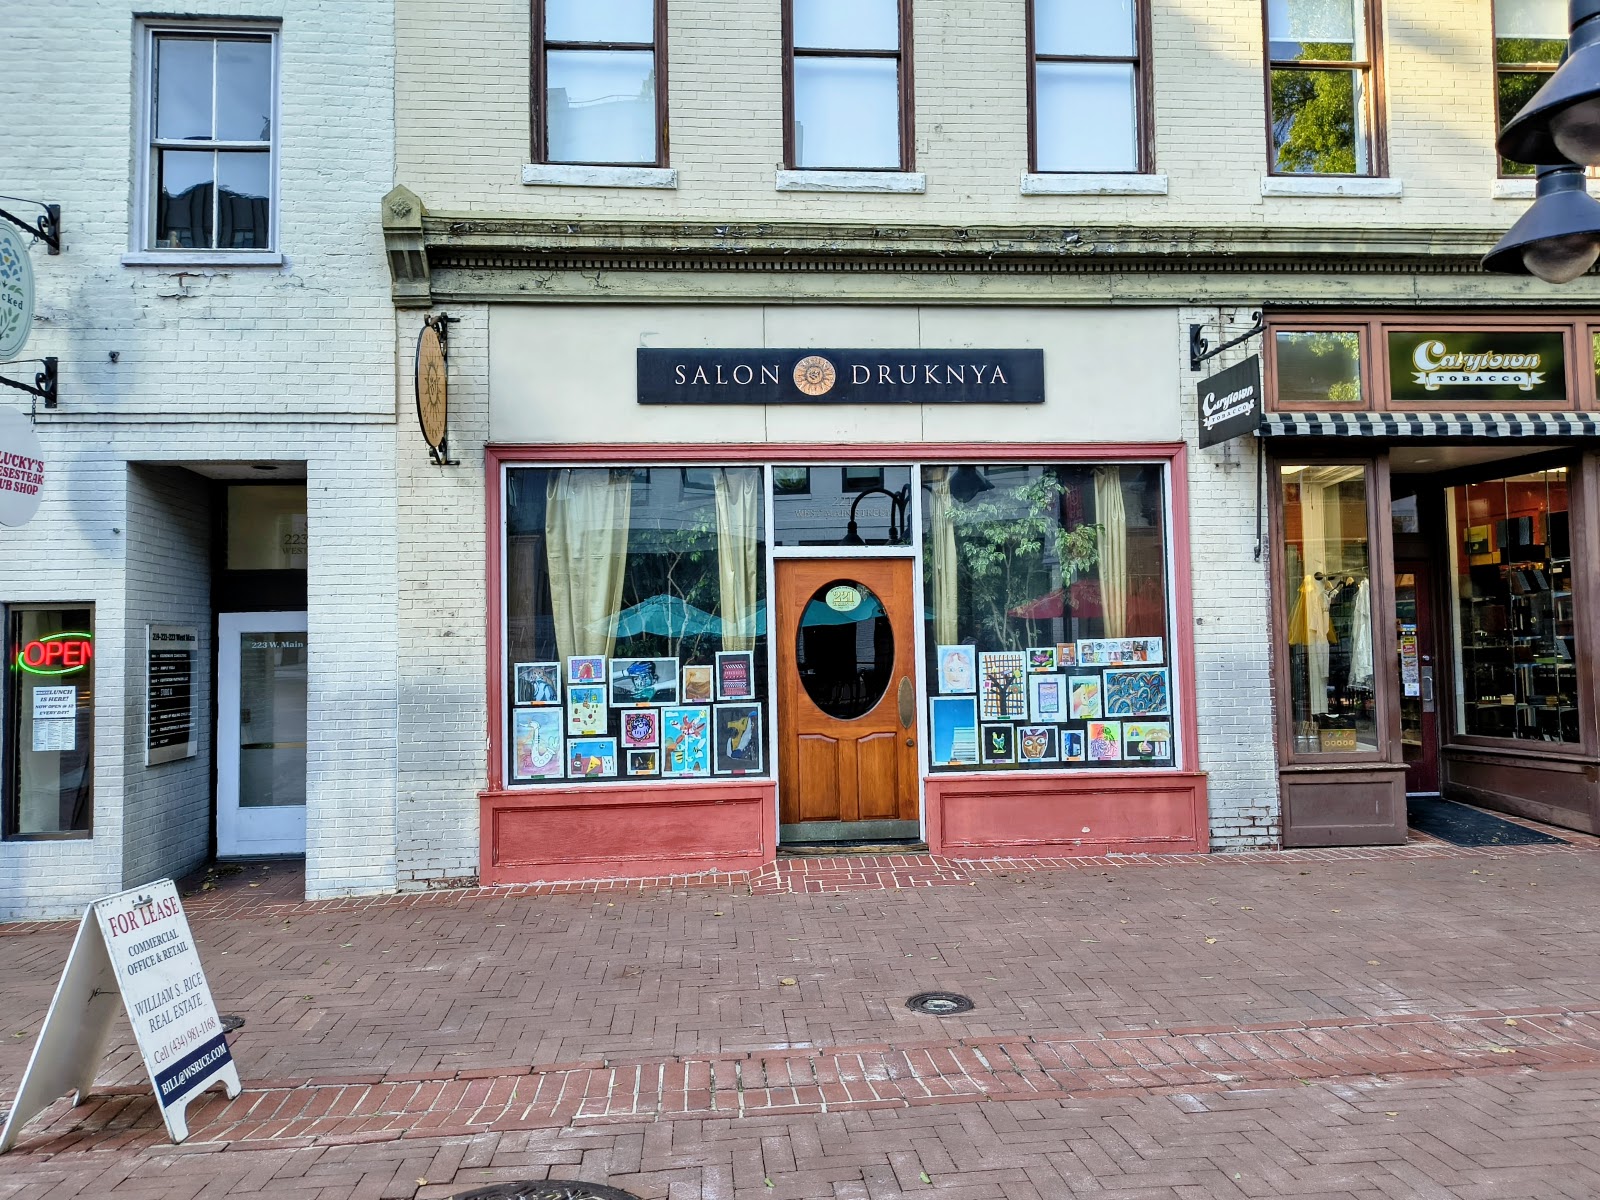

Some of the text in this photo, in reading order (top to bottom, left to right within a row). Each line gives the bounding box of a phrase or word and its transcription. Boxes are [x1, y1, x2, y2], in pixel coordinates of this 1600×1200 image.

[1412, 340, 1541, 373] Carytown
[674, 363, 1009, 386] SALON DRUKNYA
[1202, 385, 1254, 417] Carytown
[1211, 404, 1247, 422] TOBACCO
[13, 481, 39, 495] SHOP
[284, 533, 307, 545] 223
[832, 590, 855, 602] 221
[251, 641, 268, 649] 223
[281, 640, 304, 648] Main
[108, 896, 180, 938] FOR LEASE
[127, 941, 189, 976] OFFICE & RETAIL
[128, 928, 180, 957] COMMERCIAL
[134, 972, 203, 1017] WILLIAM S. RICE
[148, 992, 203, 1033] REAL ESTATE
[153, 1016, 217, 1064] Cell (434) 981-1168
[160, 1043, 227, 1096] BILL@WSRICE.COM
